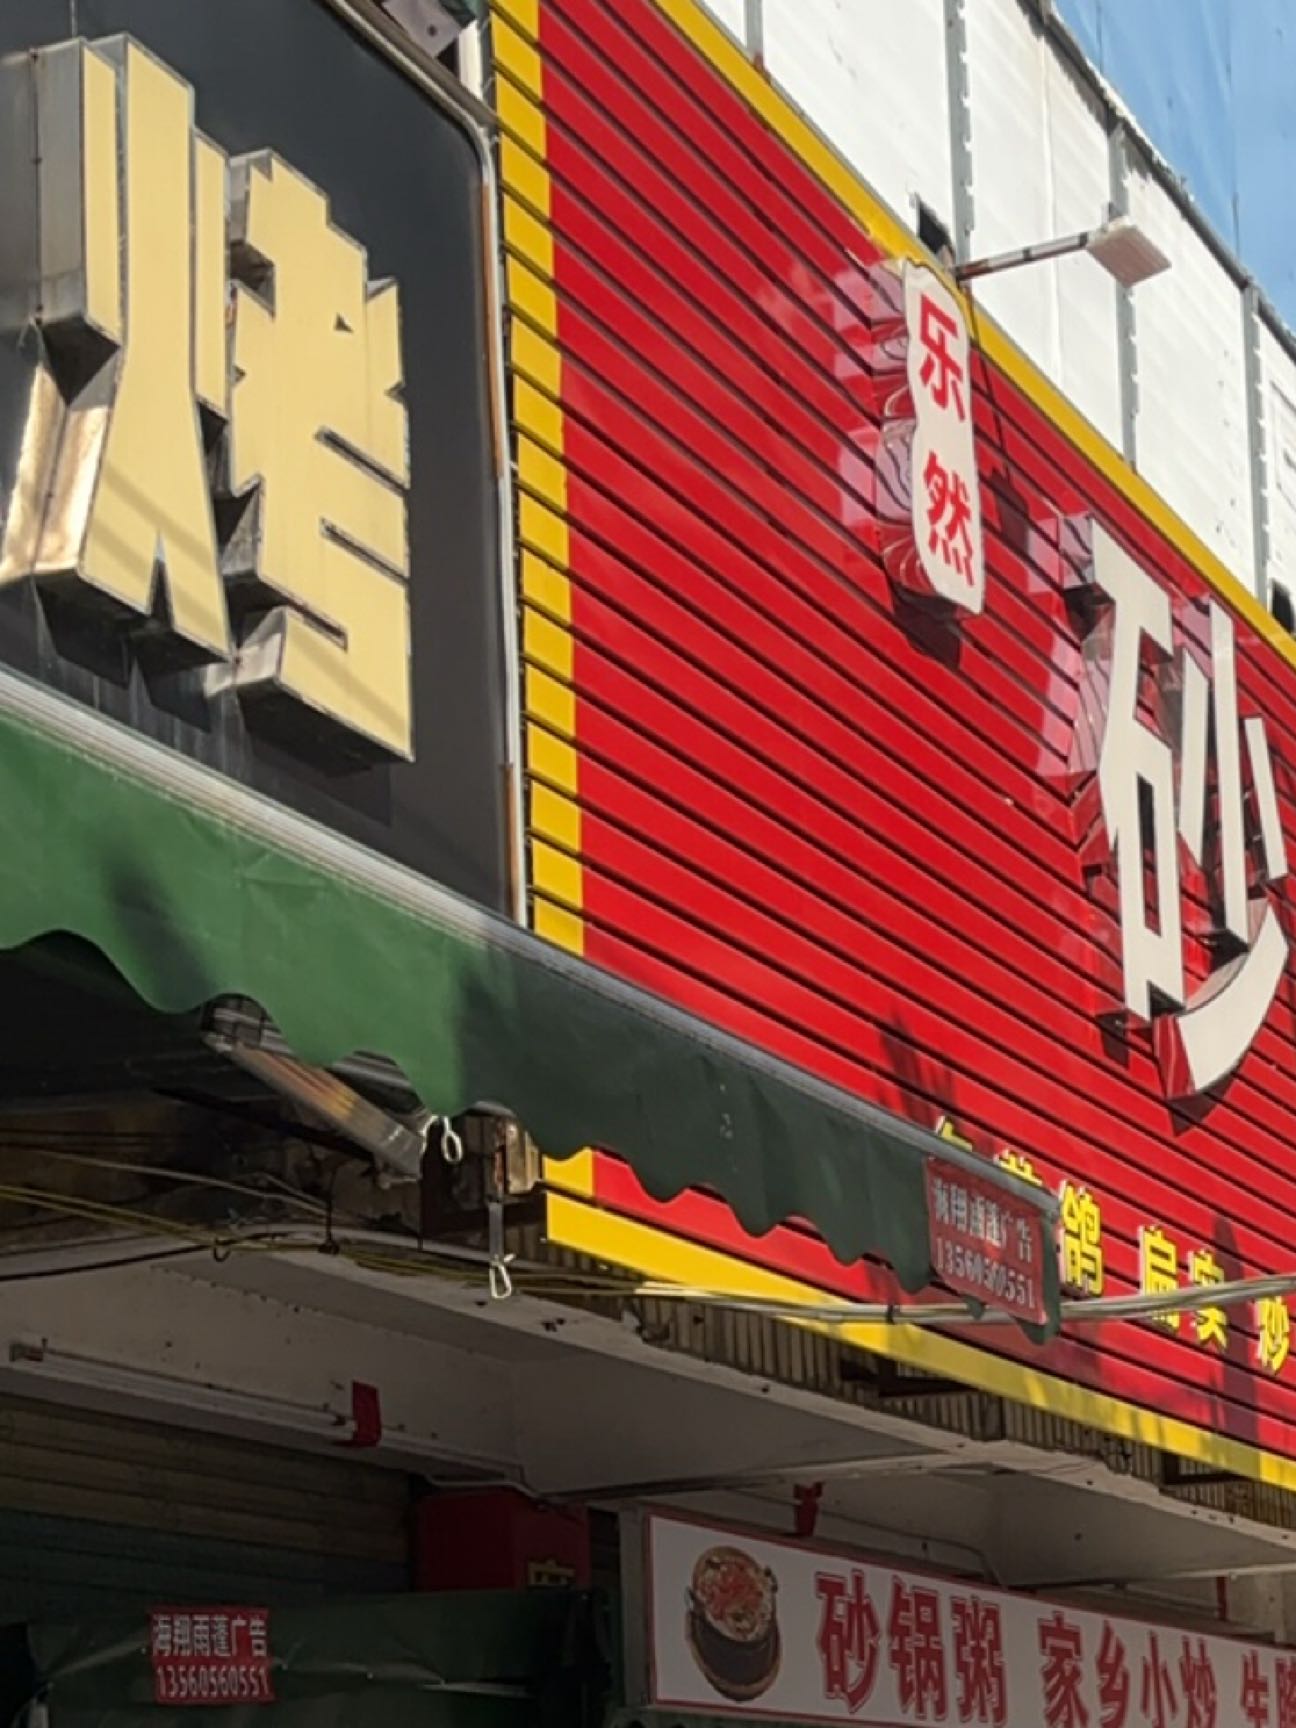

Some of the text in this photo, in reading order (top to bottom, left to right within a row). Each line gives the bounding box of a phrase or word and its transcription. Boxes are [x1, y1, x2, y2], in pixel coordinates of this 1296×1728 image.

[918, 306, 976, 588] 乐然
[156, 1664, 271, 1699] 13560560551
[815, 1570, 1007, 1728] 砂锅粥
